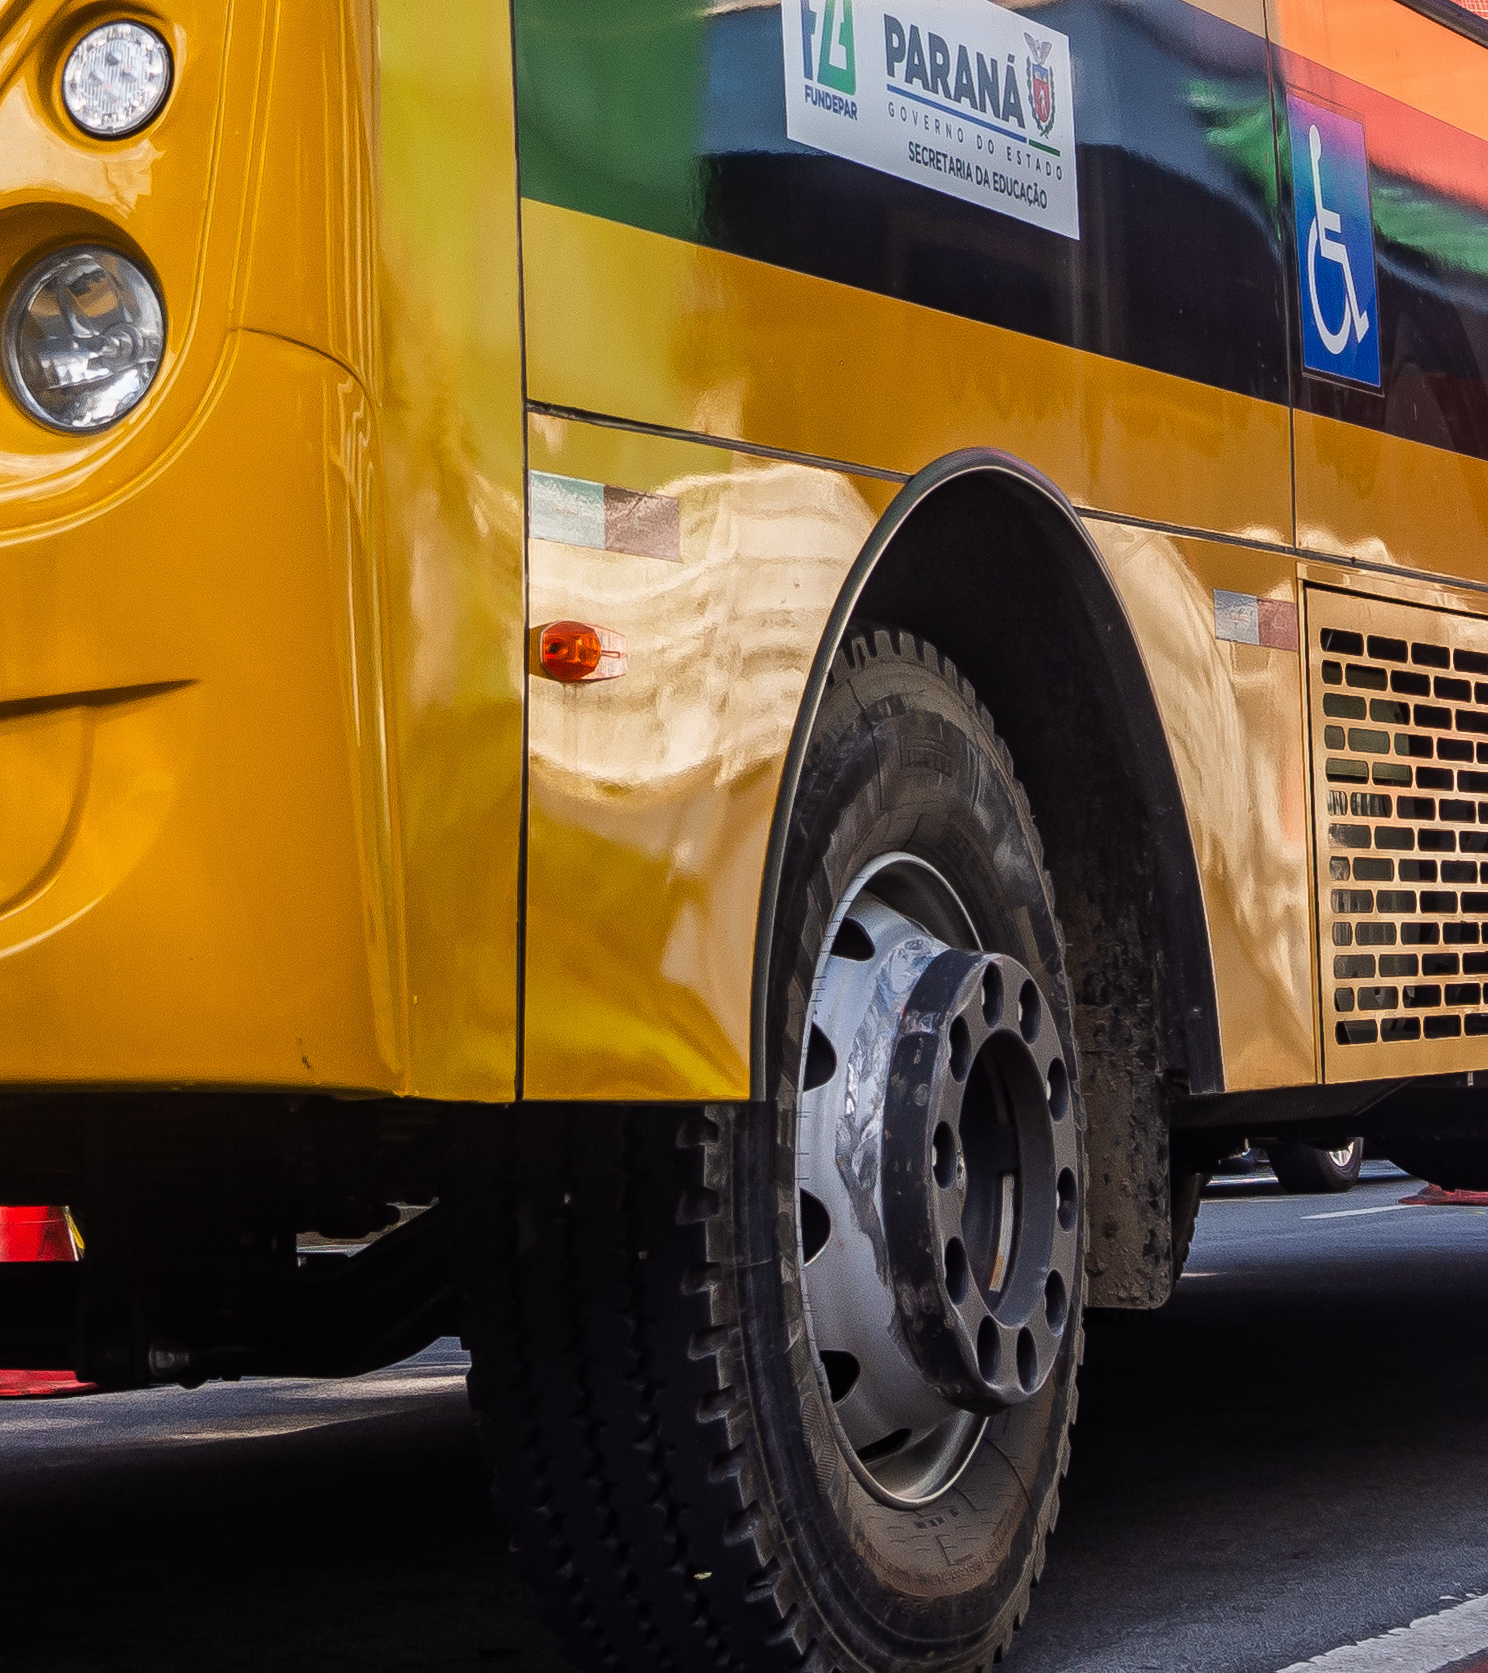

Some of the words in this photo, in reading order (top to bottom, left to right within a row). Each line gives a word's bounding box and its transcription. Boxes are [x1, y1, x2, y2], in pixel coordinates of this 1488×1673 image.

[804, 84, 858, 121] FUNDEPAR
[884, 13, 1026, 130] PARANÁ
[887, 101, 964, 144] GOVERNO
[976, 133, 995, 155] DO
[1006, 145, 1063, 181] ESTADO
[908, 140, 974, 183] SECRETARIA
[975, 164, 991, 190] DA
[992, 170, 1048, 210] EDUCAÇÃO
